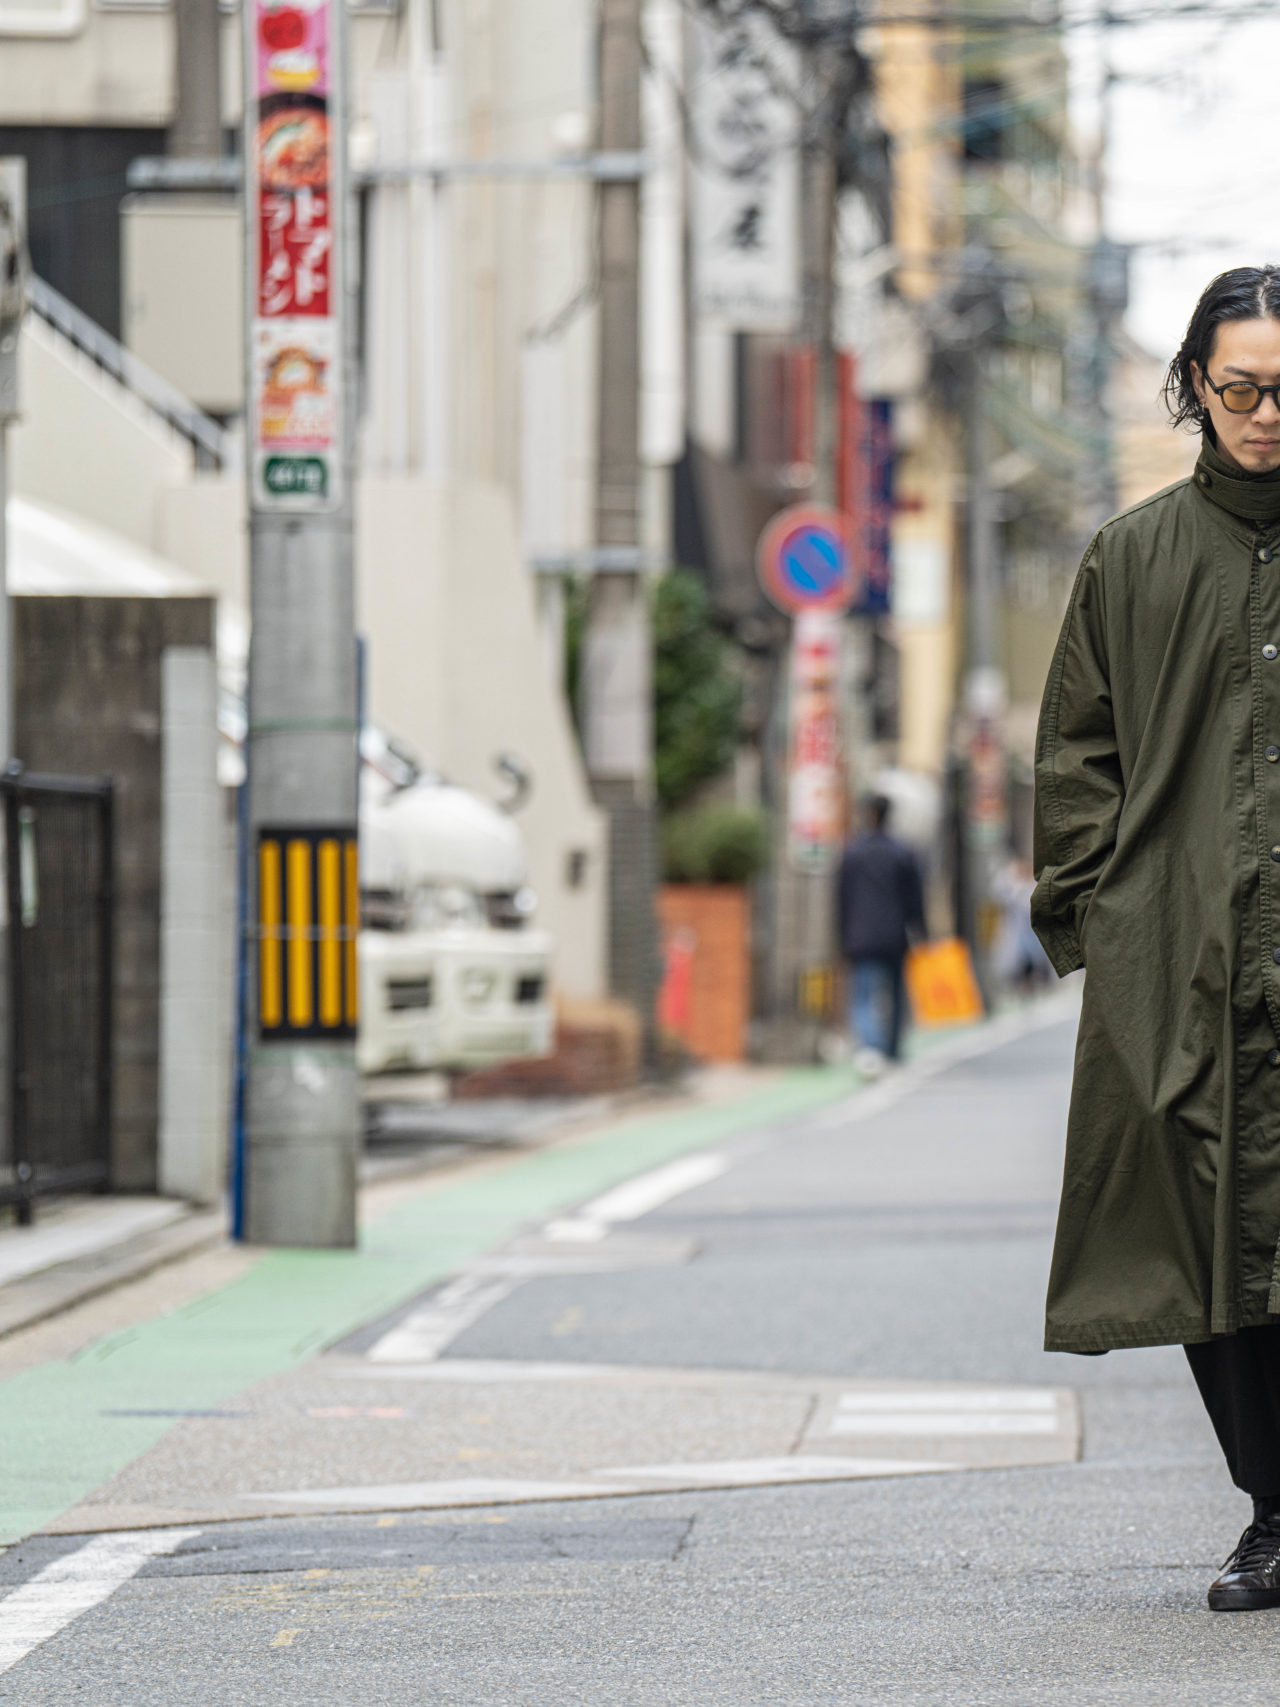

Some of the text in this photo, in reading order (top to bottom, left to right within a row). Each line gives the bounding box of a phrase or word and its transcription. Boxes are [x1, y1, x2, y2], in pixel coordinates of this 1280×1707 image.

[261, 194, 293, 314] ラーメン
[288, 186, 332, 305] トマト
